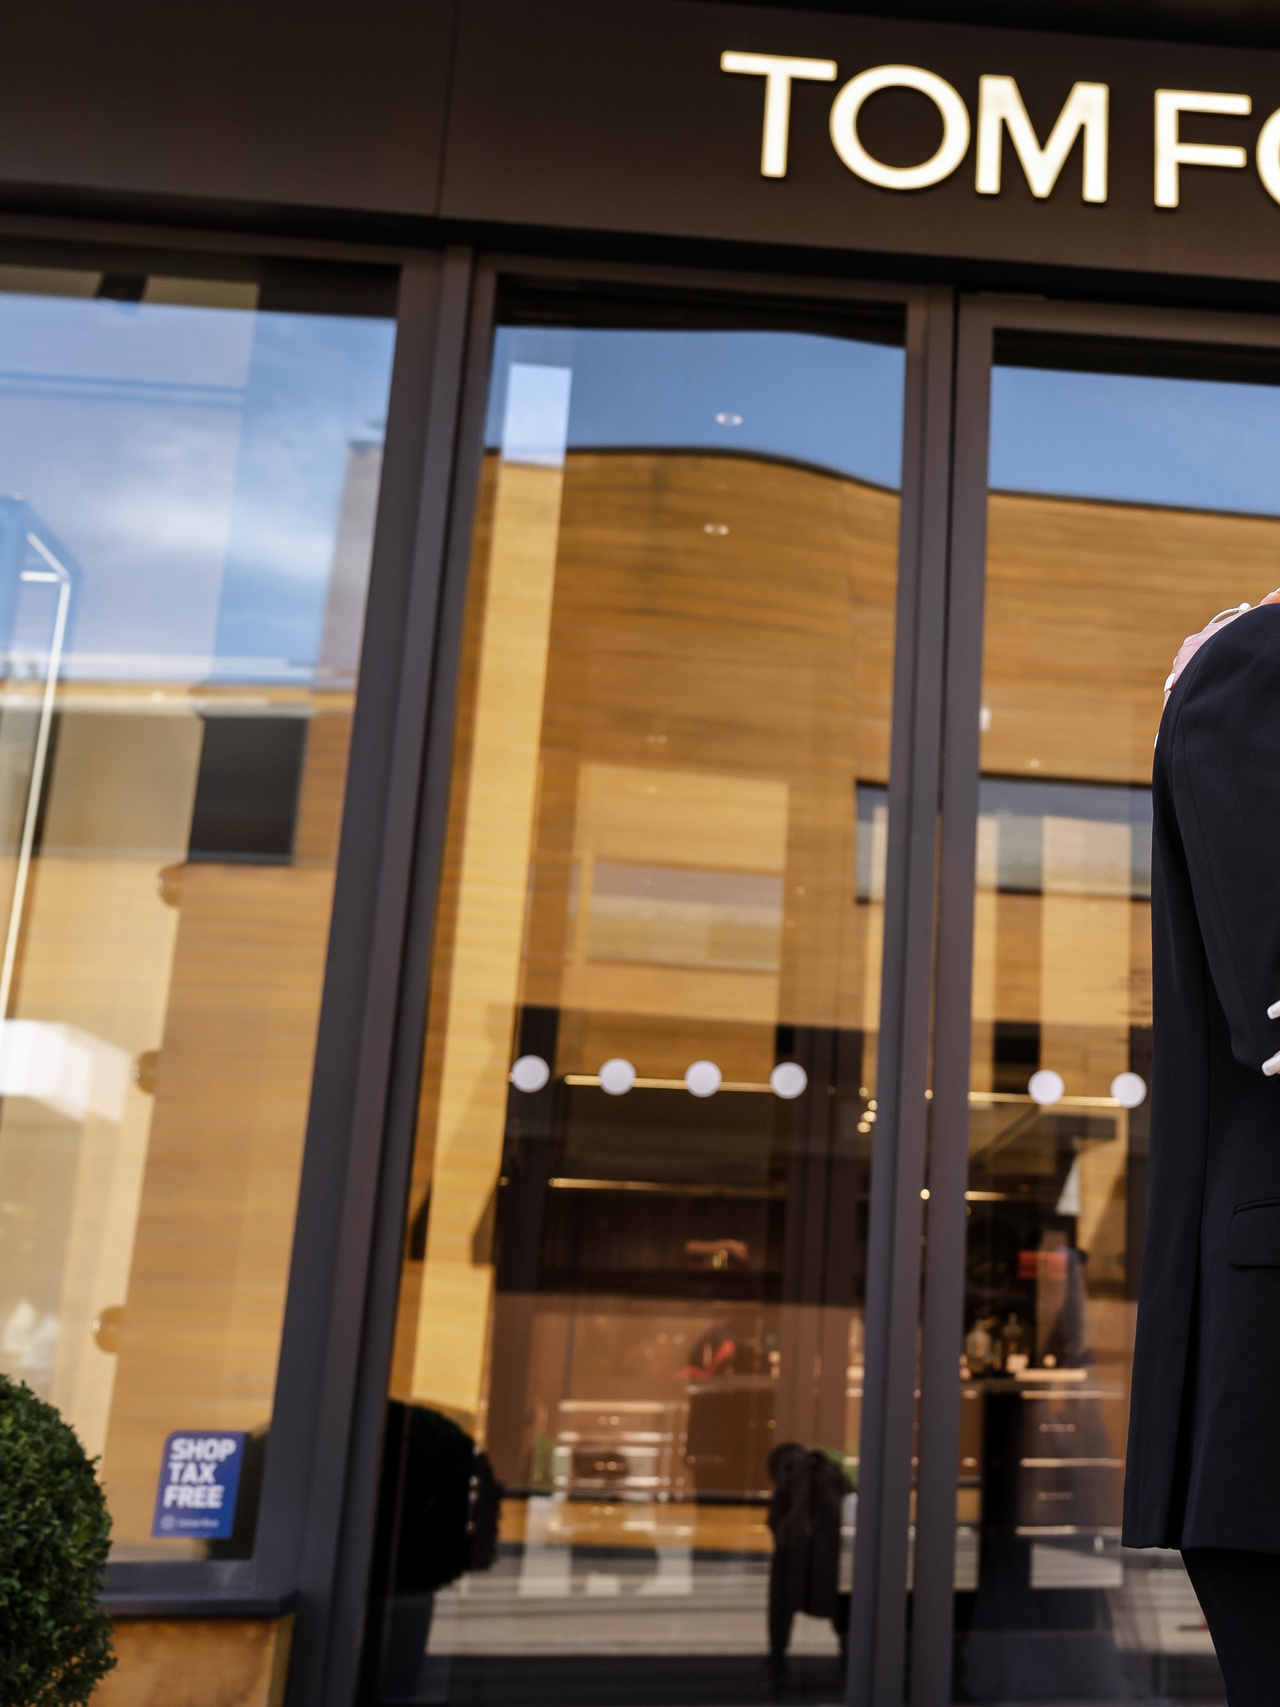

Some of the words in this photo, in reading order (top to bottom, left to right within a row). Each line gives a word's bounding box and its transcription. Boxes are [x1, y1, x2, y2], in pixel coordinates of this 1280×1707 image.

[720, 50, 1109, 203] TOM
[169, 1438, 237, 1462] SHOP
[168, 1461, 218, 1484] TAX
[163, 1484, 225, 1509] FREE
